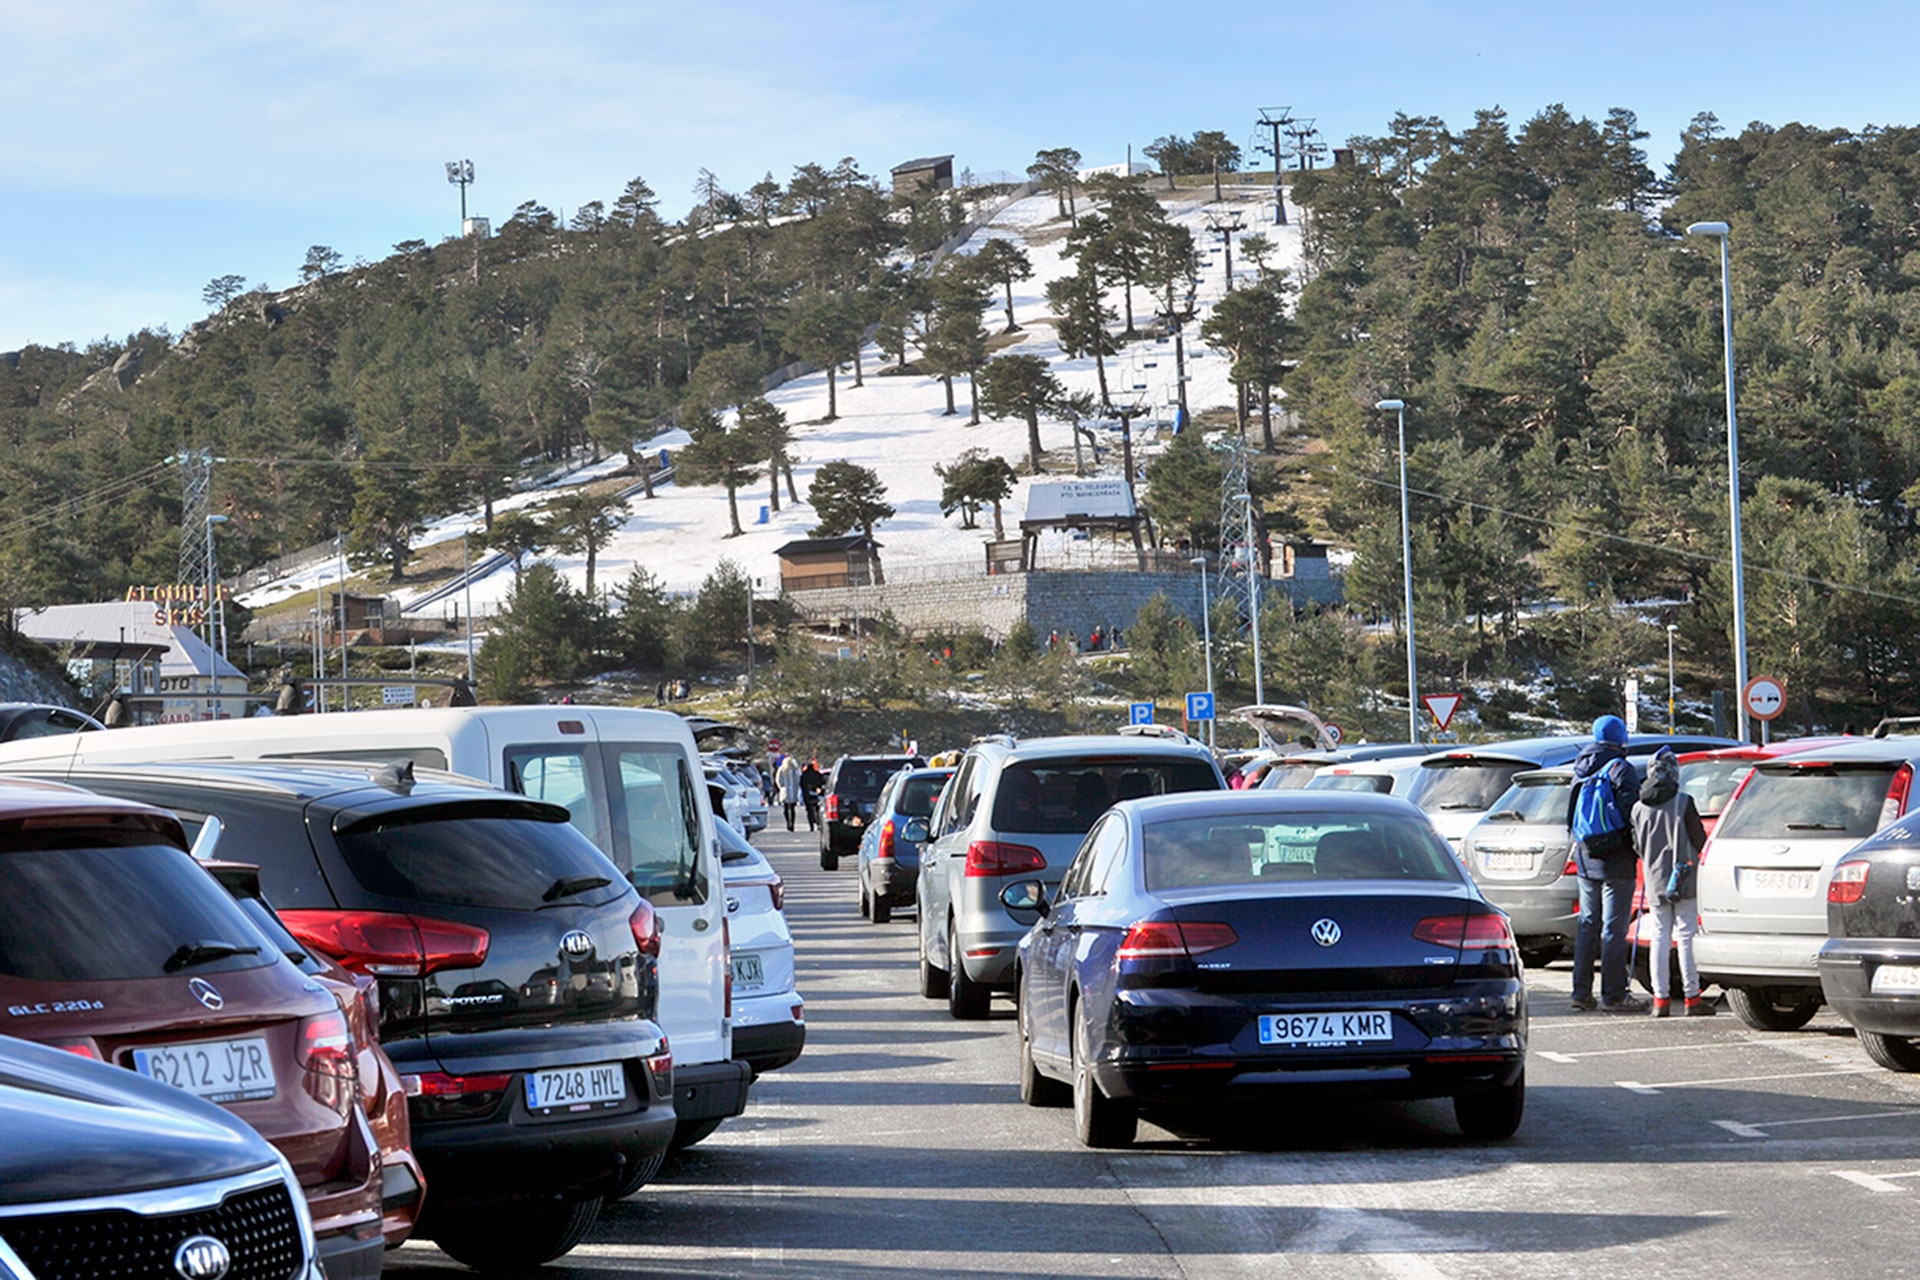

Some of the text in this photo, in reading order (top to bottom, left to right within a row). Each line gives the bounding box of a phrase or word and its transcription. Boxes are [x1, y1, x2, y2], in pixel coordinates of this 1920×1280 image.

[154, 608, 204, 626] SKIS
[1135, 706, 1149, 723] P
[1192, 696, 1208, 717] P
[566, 936, 590, 952] KIA
[736, 960, 760, 981] KJX
[8, 1003, 50, 1016] GLC
[1275, 1014, 1386, 1038] 9674 KMR
[151, 1045, 267, 1088] 6212 JZR
[542, 1068, 620, 1102] 7248 HYL
[185, 1246, 224, 1276] KIA
